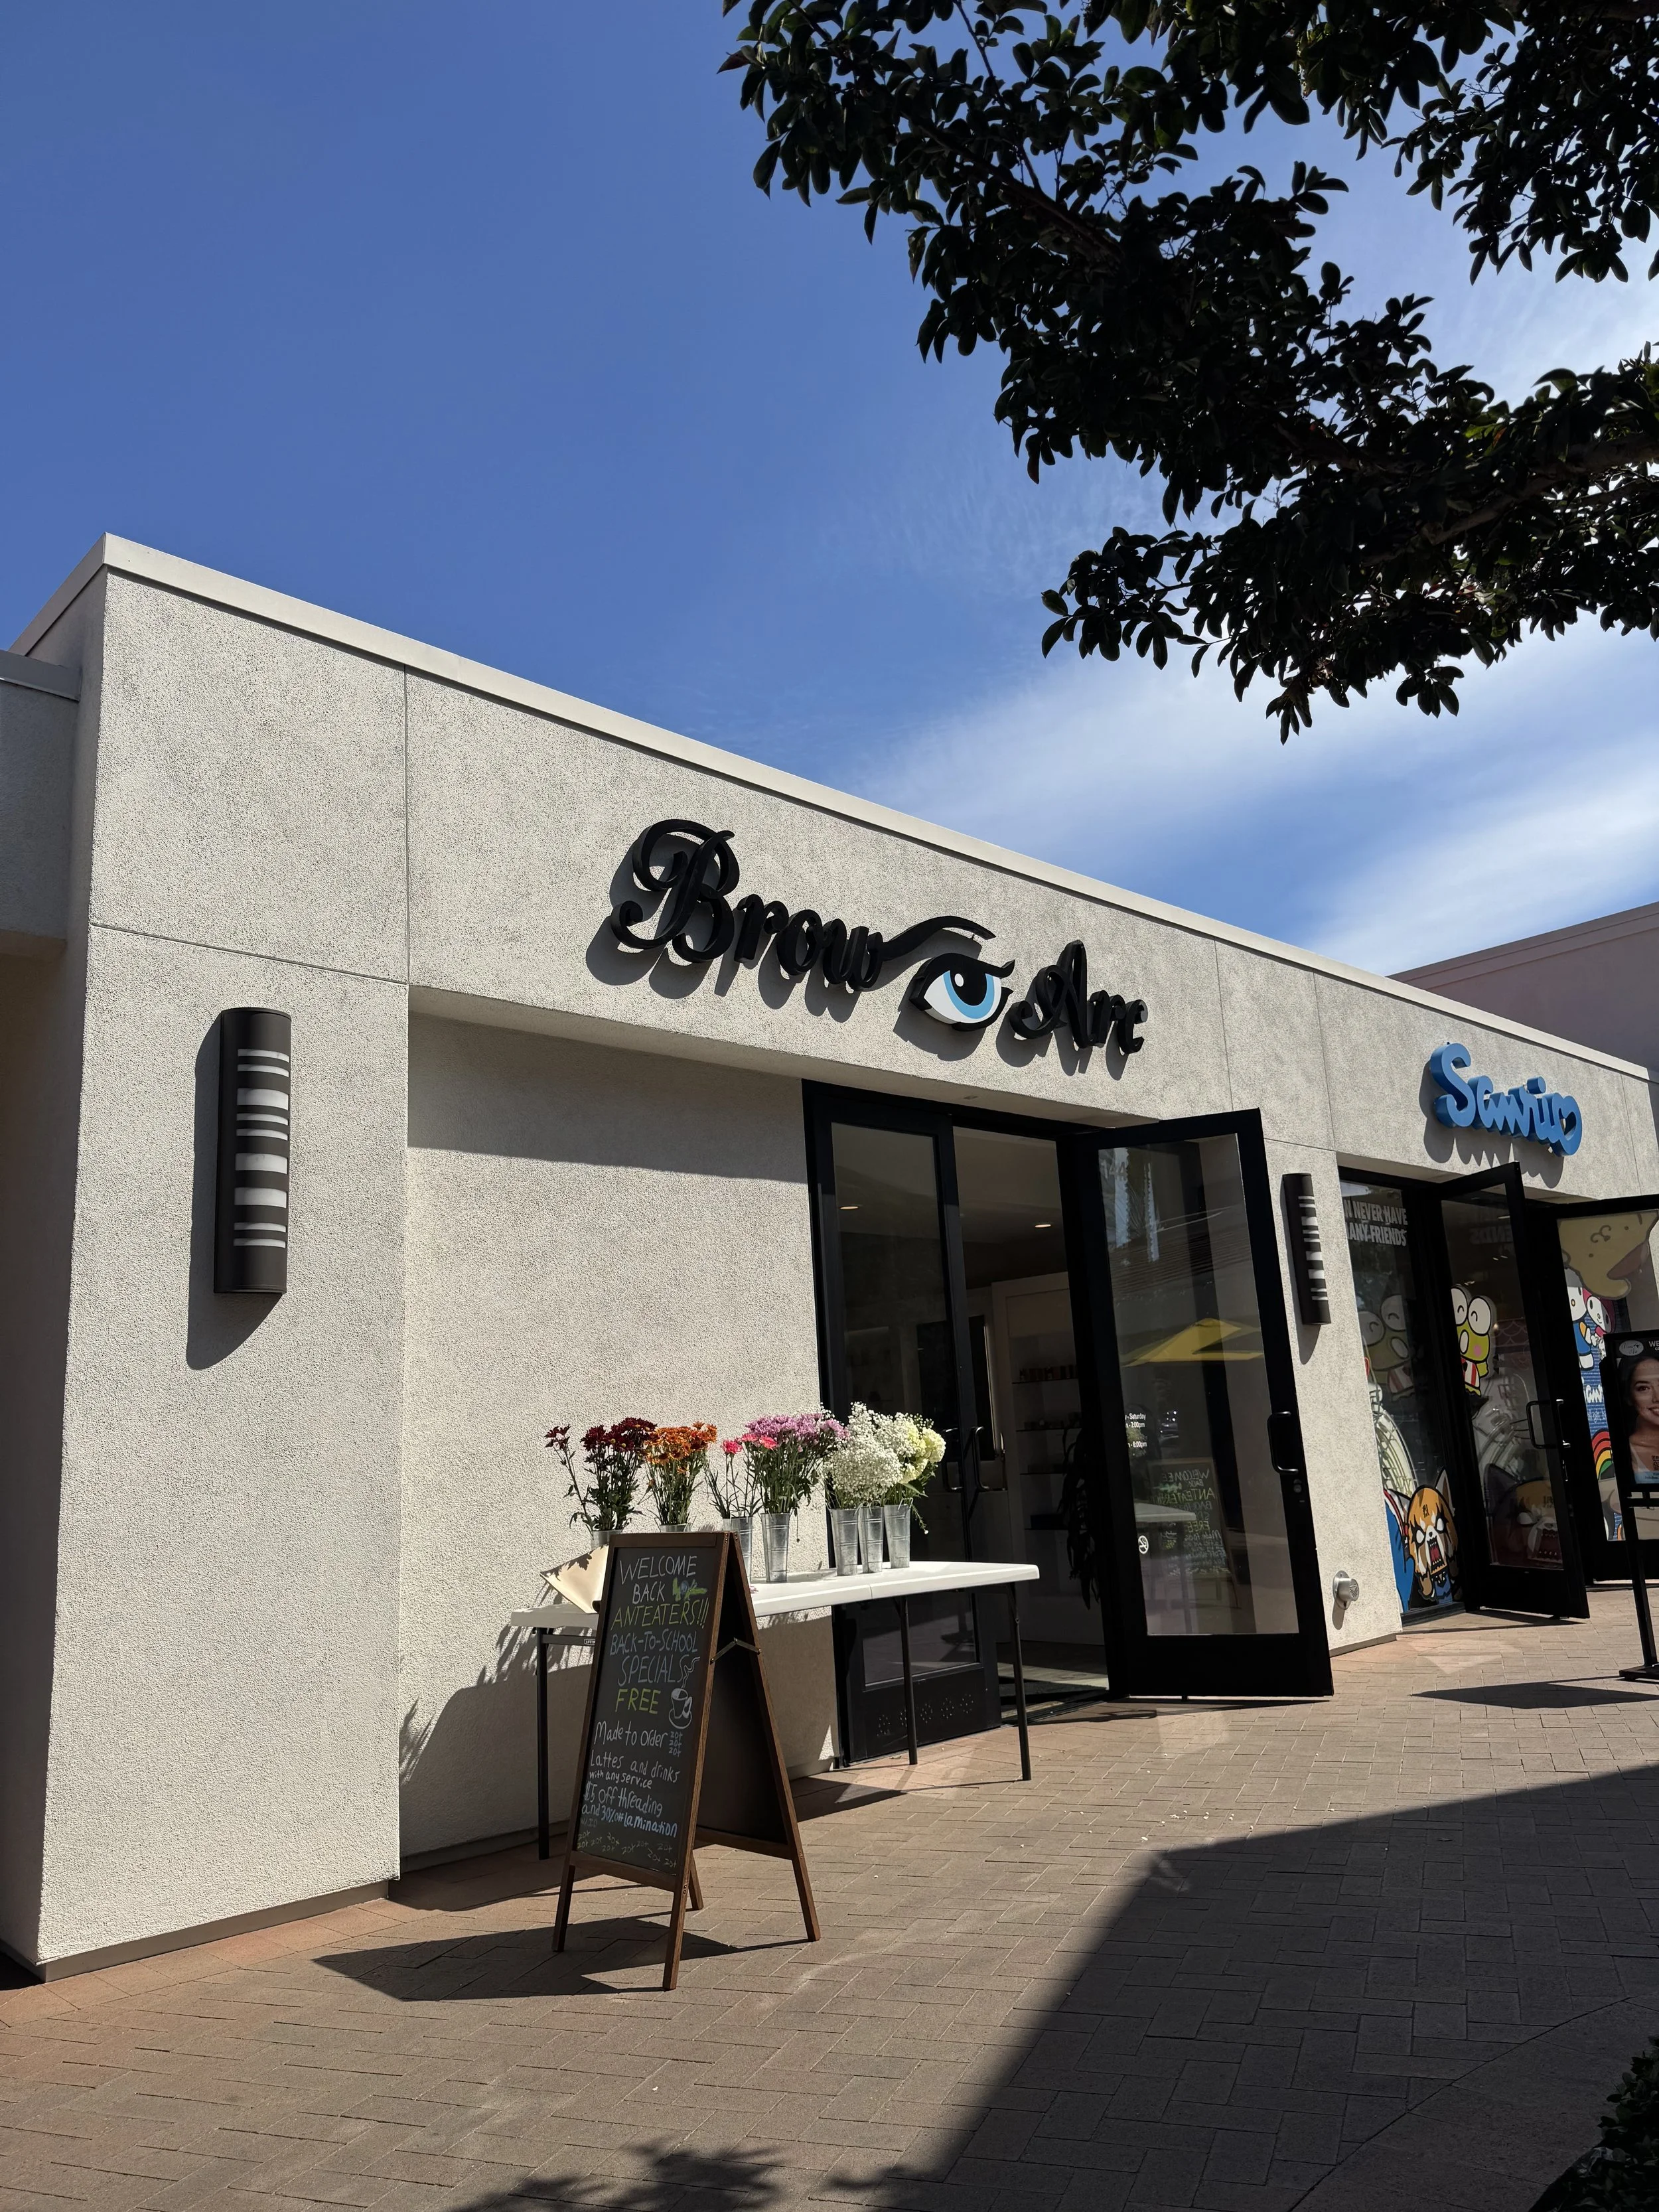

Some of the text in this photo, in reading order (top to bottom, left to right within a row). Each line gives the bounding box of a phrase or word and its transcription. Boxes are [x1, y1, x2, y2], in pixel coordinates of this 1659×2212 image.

[610, 818, 1149, 1055] Brow Arc
[1430, 1042, 1583, 1157] Sanrio
[1352, 1200, 1384, 1222] NEVER
[1382, 1205, 1408, 1226] HAVE
[1369, 1224, 1407, 1247] FRIENDS
[619, 1554, 697, 1585] WELCOME
[632, 1581, 666, 1605] BACK
[610, 1597, 710, 1631] ANTEATERS!!!
[609, 1627, 698, 1656] BACK-TO-SCHOOL
[617, 1654, 690, 1687] SPECIALS
[614, 1687, 662, 1715] FREE
[594, 1720, 624, 1745] Made
[625, 1720, 637, 1747] to
[589, 1770, 653, 1789] with any service
[590, 1749, 680, 1783] Lattes and drinks
[581, 1803, 601, 1816] and
[617, 1787, 663, 1818] threading
